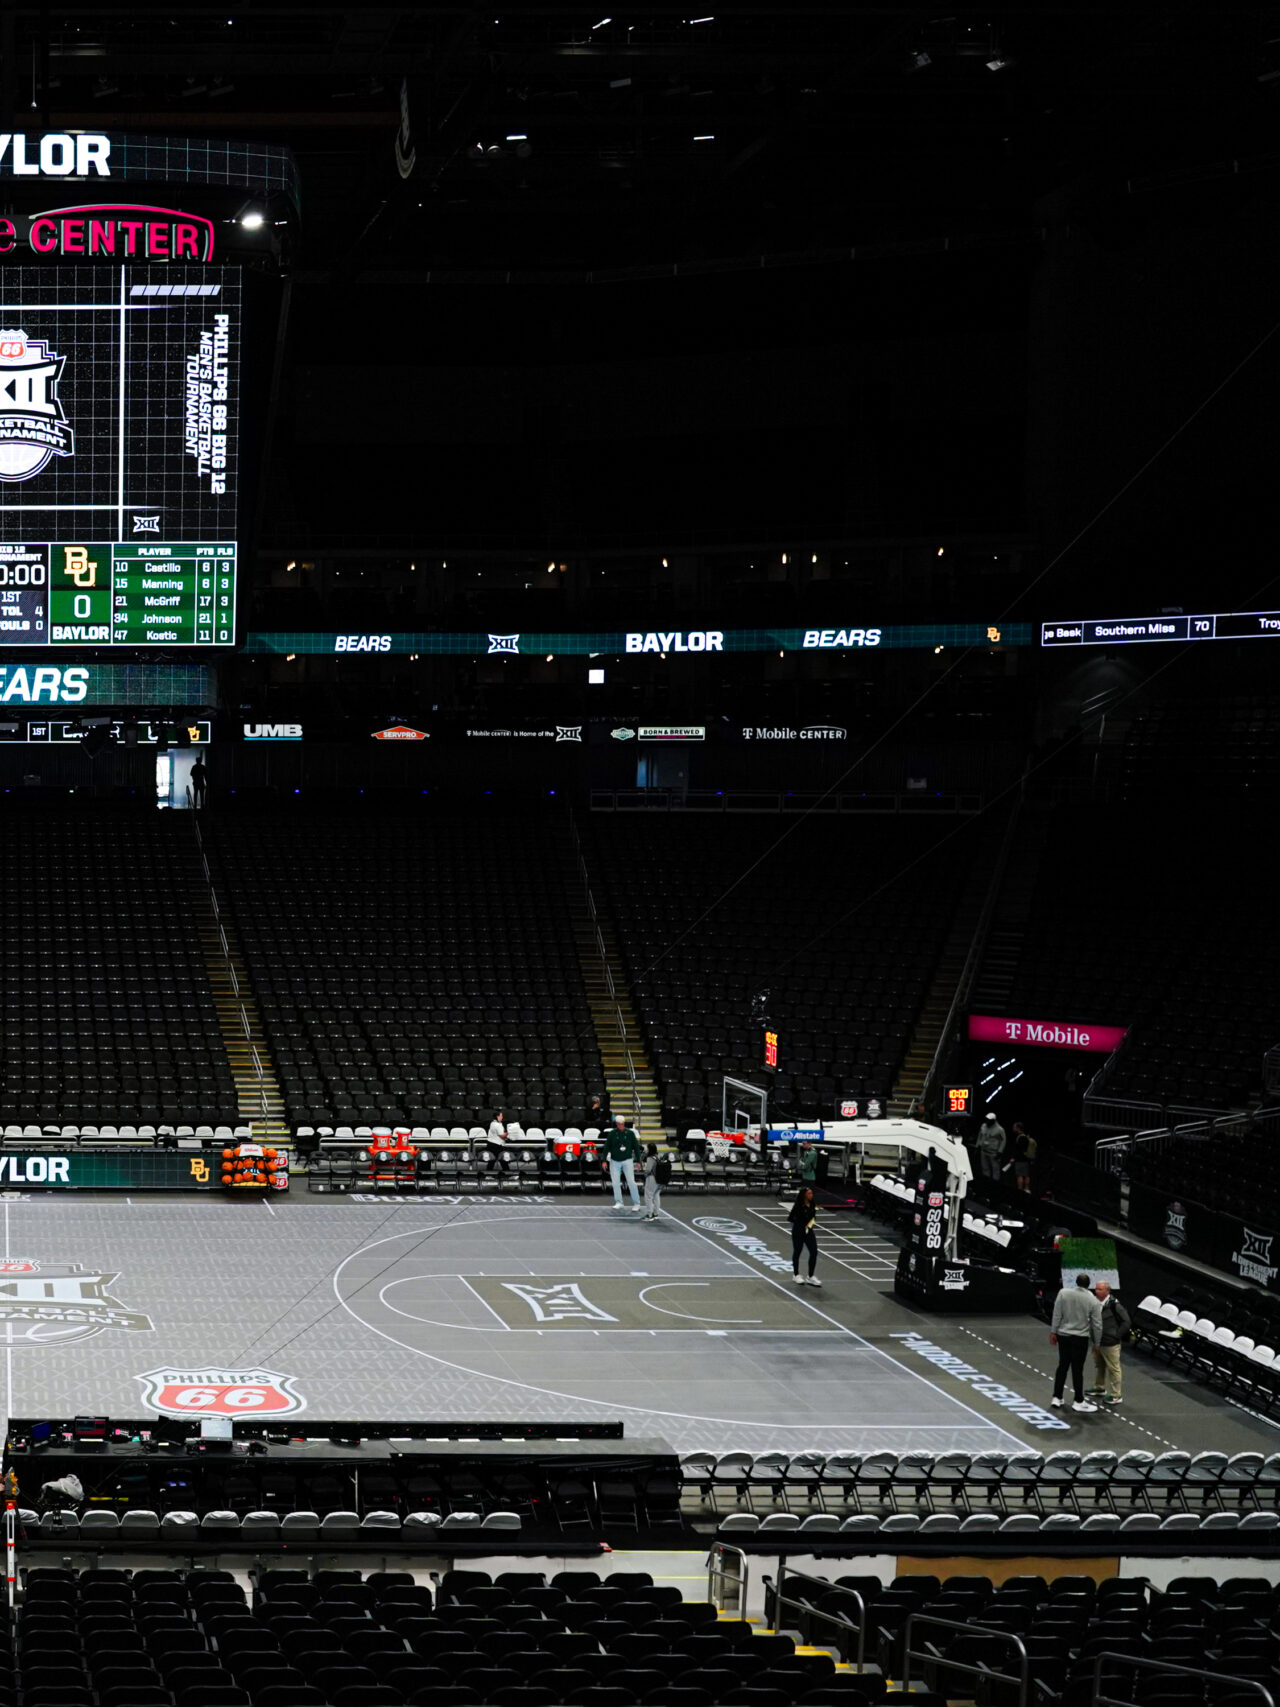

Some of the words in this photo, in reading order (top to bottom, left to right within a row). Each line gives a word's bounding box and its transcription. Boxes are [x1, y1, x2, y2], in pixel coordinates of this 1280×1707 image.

[30, 218, 201, 258] CENTER
[2, 343, 21, 355] 66
[200, 331, 213, 379] MEN'S
[213, 314, 229, 401] PHILLIPS
[185, 354, 200, 457] TOURNAMENT
[213, 405, 227, 430] 66
[198, 383, 212, 477] BASKETBALL
[211, 434, 226, 469] BIG
[211, 472, 226, 494] 12
[137, 547, 172, 556] PLAYER
[196, 547, 214, 556] PTS
[115, 562, 128, 572] 10
[144, 562, 181, 572] Castillo
[221, 562, 229, 572] 3
[115, 578, 128, 589] 15
[142, 579, 184, 590] Manning
[221, 578, 229, 589] 3
[1, 591, 22, 602] 1ST
[115, 596, 127, 606] 21
[144, 596, 181, 606] McGriff
[199, 596, 211, 606] 17
[220, 596, 228, 606] 3
[0, 605, 23, 616] TOL
[34, 606, 44, 616] 4
[73, 594, 91, 619] 0
[35, 620, 43, 631] 0
[114, 613, 129, 623] 34
[141, 614, 182, 624] Johnson
[199, 613, 211, 623] 21
[52, 626, 109, 641] BAYLOR
[114, 630, 128, 640] 47
[146, 630, 177, 640] Kostic
[199, 630, 210, 640] 11
[1095, 625, 1146, 637] Southern
[1148, 623, 1176, 634] Miss
[1195, 621, 1210, 631] 70
[334, 635, 392, 652] BEARS
[625, 631, 724, 653] BAYLOR
[802, 629, 881, 648] BEARS
[32, 727, 47, 736] 1ST
[243, 723, 303, 738] UMB
[742, 727, 753, 740] T
[756, 727, 798, 740] Mobile
[799, 730, 843, 740] CENTER
[1006, 1022, 1021, 1040] T
[1026, 1023, 1090, 1047] Mobile
[765, 1044, 777, 1067] 30
[948, 1088, 969, 1099] 10:00
[950, 1099, 965, 1111] 30
[793, 1131, 820, 1140] Allstate
[565, 1144, 573, 1153] G
[356, 1193, 471, 1206] Busey
[468, 1195, 556, 1204] BANK
[926, 1208, 942, 1222] GO
[926, 1222, 941, 1235] GO
[926, 1235, 941, 1248] GO
[723, 1233, 794, 1274] Allstate
[162, 1373, 272, 1385] PHILLIPS
[888, 1331, 992, 1382] T-MOBILE
[971, 1382, 1072, 1430] CENTER
[174, 1388, 269, 1407] 66
